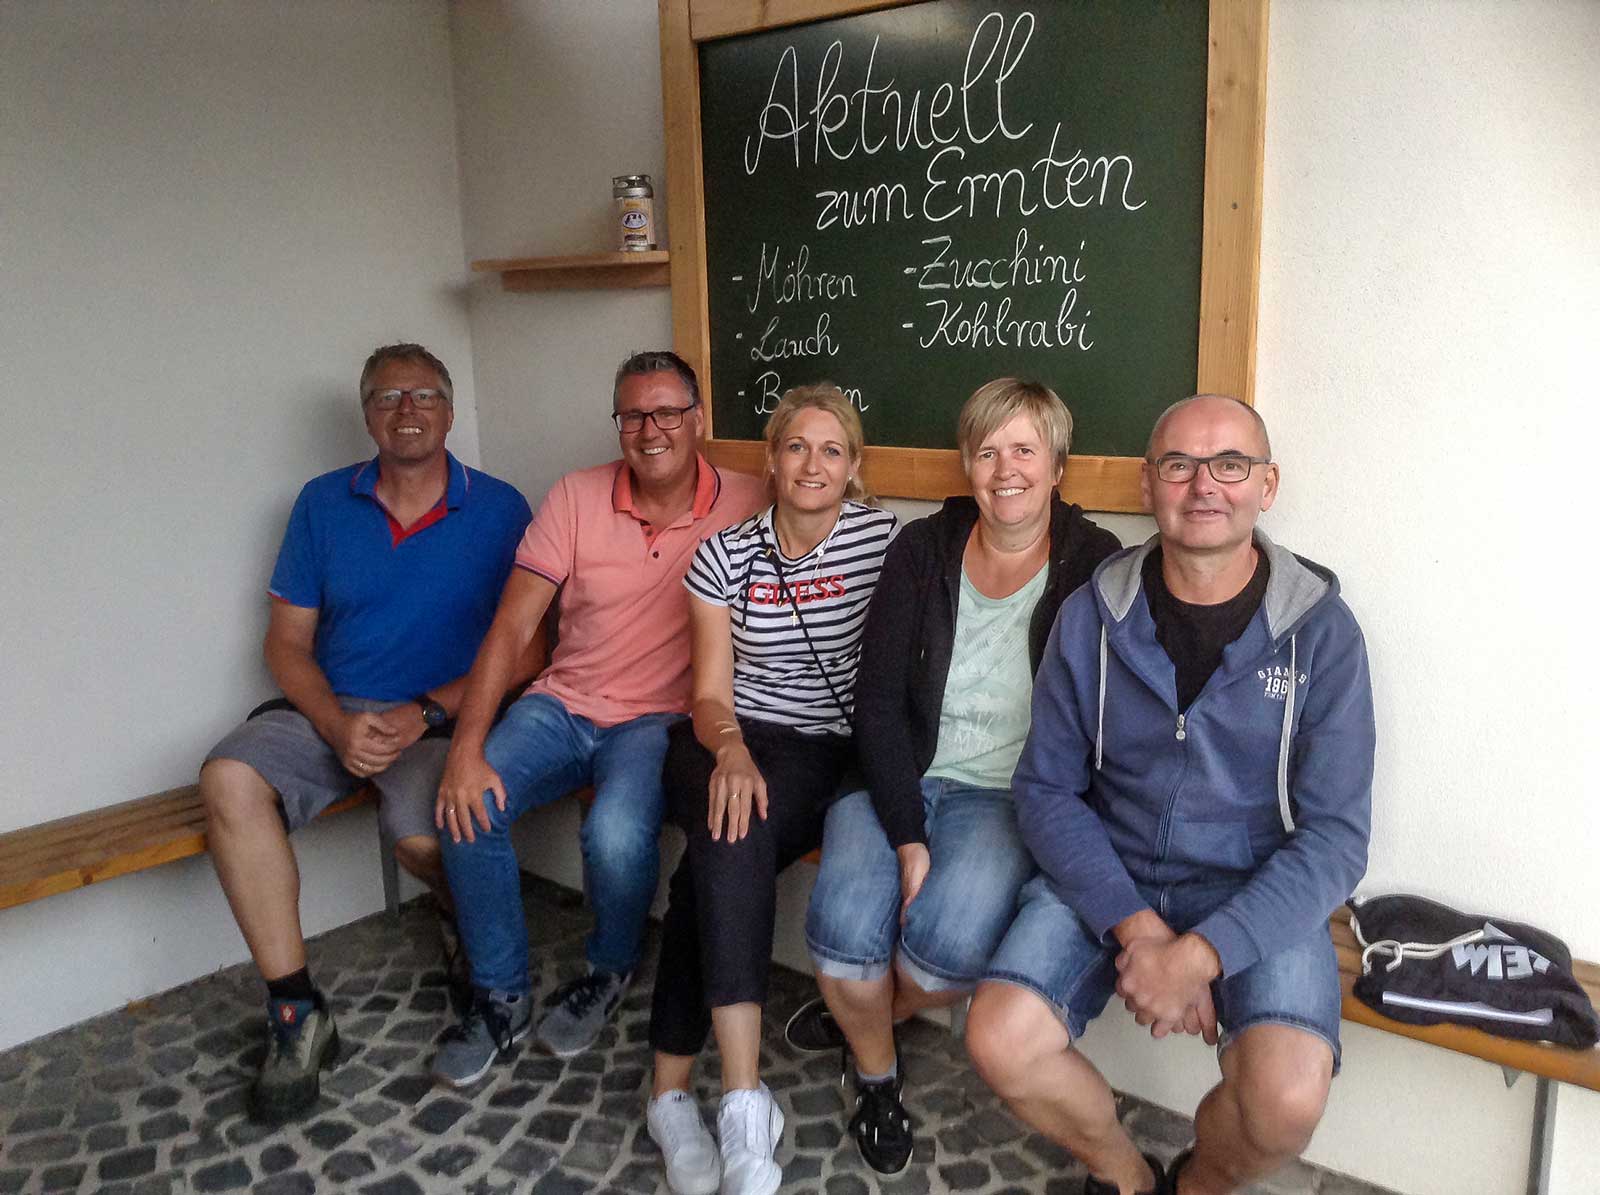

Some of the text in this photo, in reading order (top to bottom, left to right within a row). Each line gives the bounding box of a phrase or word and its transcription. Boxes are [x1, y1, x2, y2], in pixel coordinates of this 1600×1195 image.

[744, 12, 1034, 175] Aktuell
[816, 123, 1147, 230] zum Ernten
[749, 243, 858, 313] Möhren
[918, 228, 1087, 290] Zucchini
[750, 312, 840, 362] Lauch
[919, 289, 1094, 351] Kohlrabi
[750, 575, 847, 605] GUESS
[1257, 666, 1307, 684] GIANS
